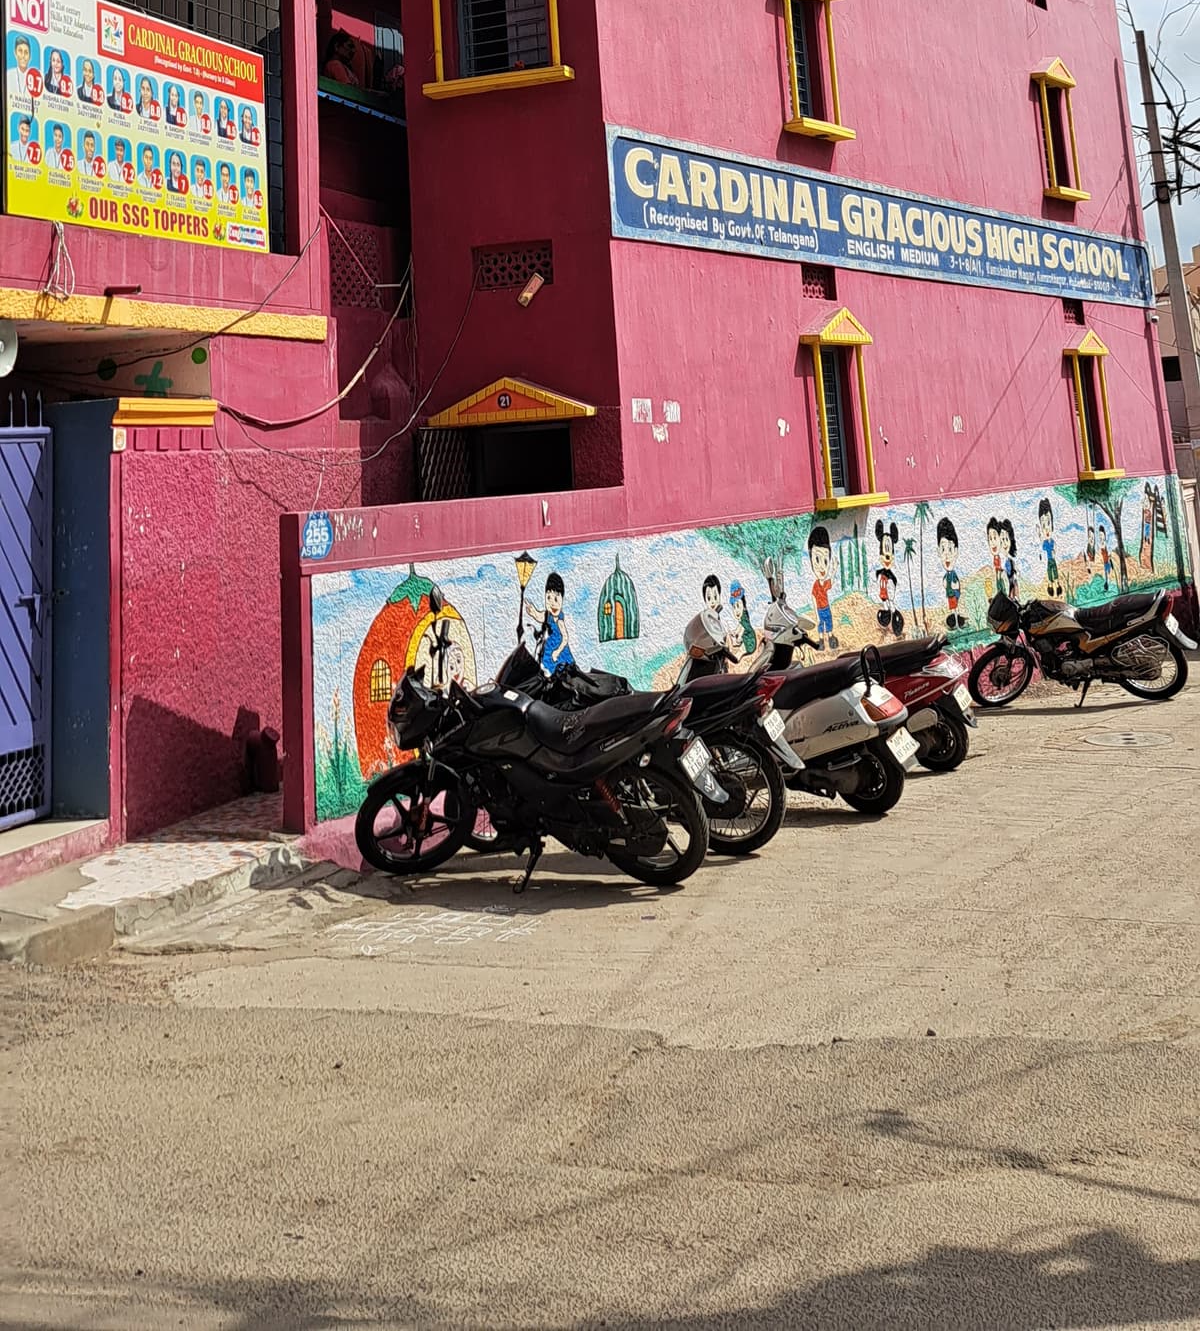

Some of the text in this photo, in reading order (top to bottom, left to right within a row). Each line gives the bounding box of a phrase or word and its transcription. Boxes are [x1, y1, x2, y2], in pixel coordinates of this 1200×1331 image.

[128, 24, 258, 84] CARDINAL GRACIOUS SCHOOL
[27, 74, 42, 92] 9.7
[60, 78, 73, 94] 9.3
[121, 95, 133, 111] 9.2
[28, 147, 41, 163] 7.7
[61, 153, 74, 169] 7.5
[93, 161, 105, 176] 7.3
[123, 167, 135, 182] 7.2
[151, 173, 162, 187] 7.2
[181, 179, 186, 191] 7
[89, 196, 118, 223] OUR
[122, 201, 150, 228] SSC
[152, 208, 209, 237] TOPPERS
[624, 147, 1131, 282] CARDINAL GRACIOUS HIGH SCHOOL
[643, 201, 708, 233] (Recognised
[712, 216, 726, 240] By
[768, 226, 819, 253] Telangana)
[846, 238, 940, 267] ENGLISH MEDIUM
[500, 395, 510, 407] 21
[305, 527, 329, 544] 255
